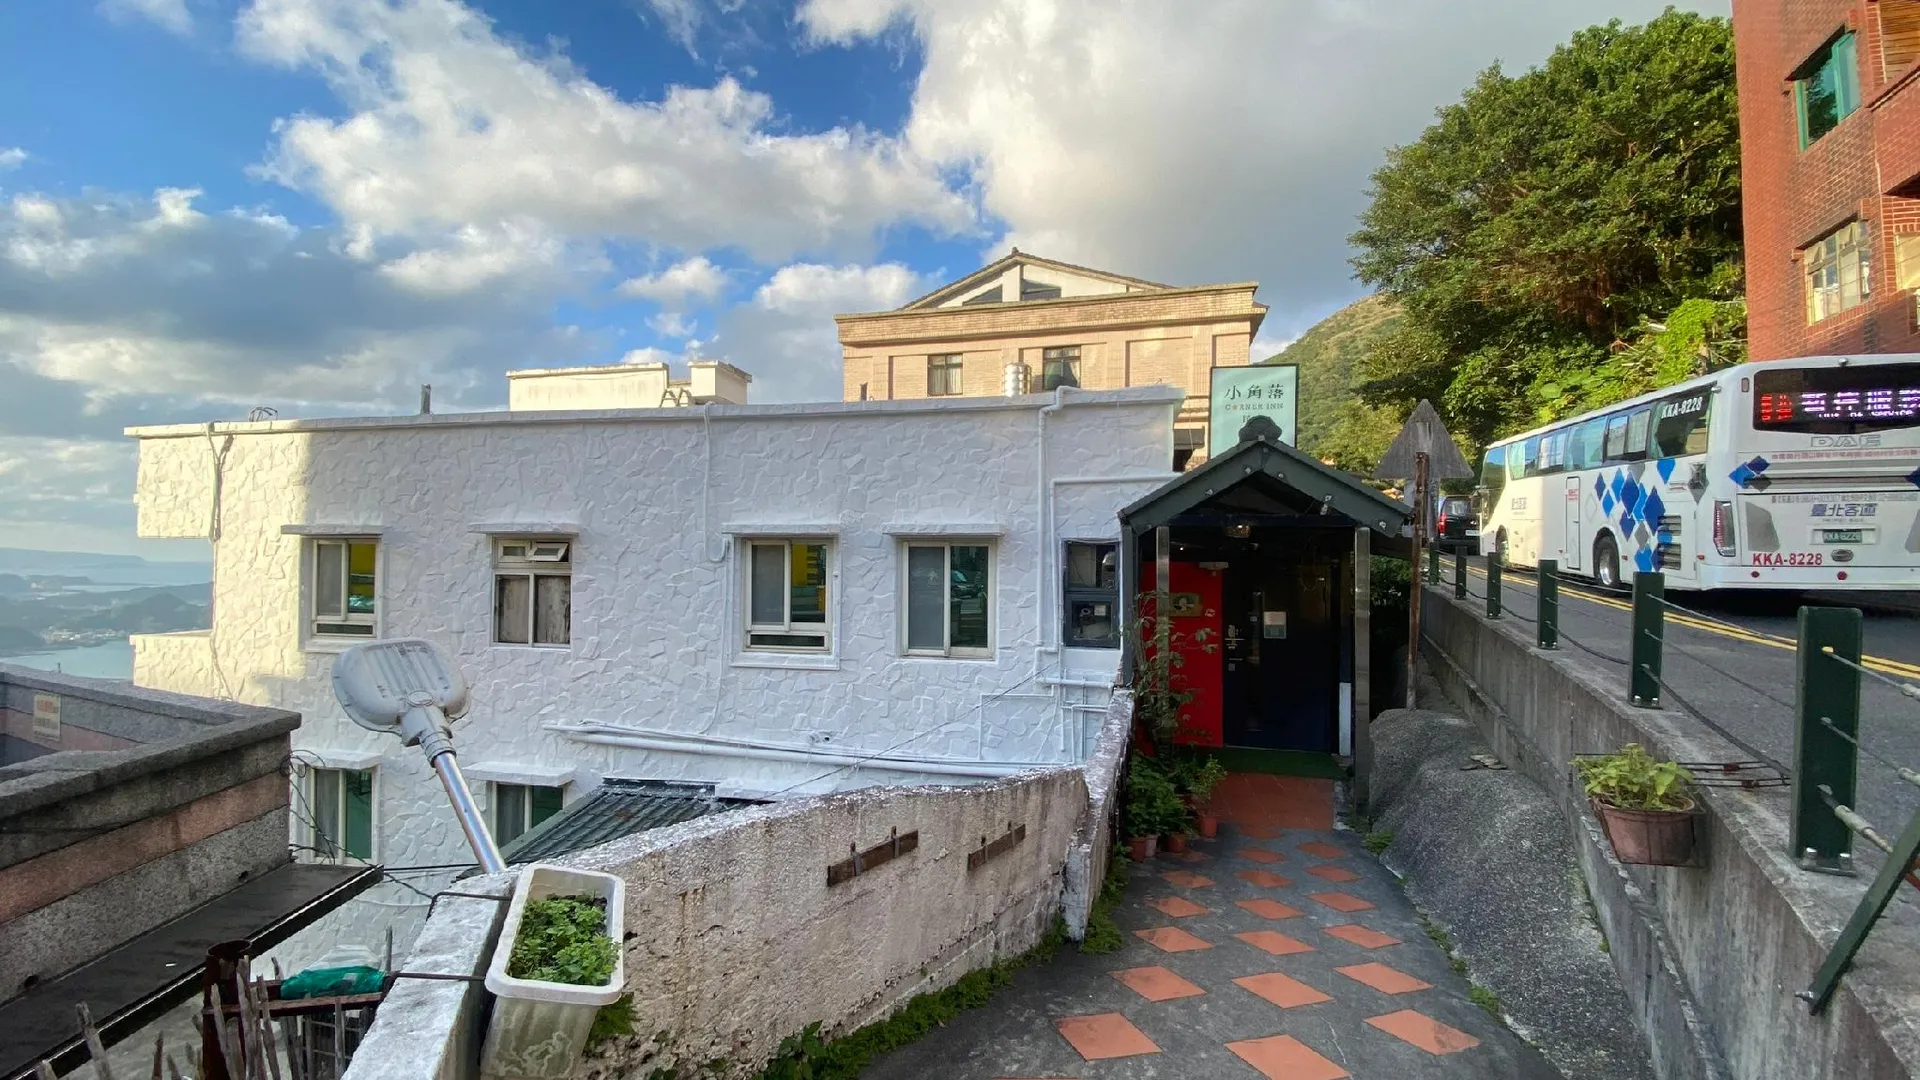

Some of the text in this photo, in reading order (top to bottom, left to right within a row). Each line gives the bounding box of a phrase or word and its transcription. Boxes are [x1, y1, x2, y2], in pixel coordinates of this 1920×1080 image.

[1224, 383, 1284, 400] 小角落
[1661, 396, 1703, 419] KKA-8228
[1752, 552, 1822, 566] KKA-8228
